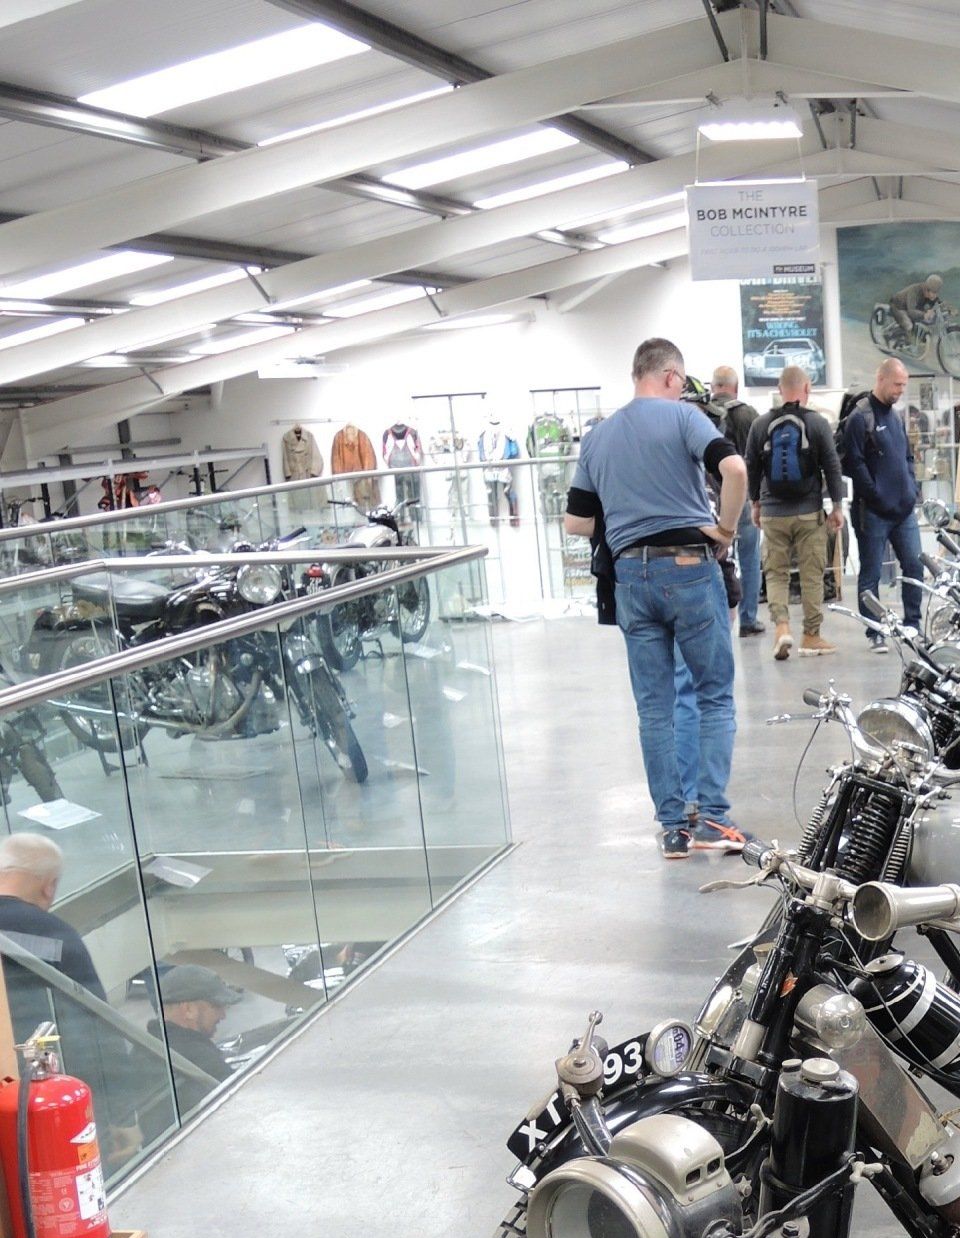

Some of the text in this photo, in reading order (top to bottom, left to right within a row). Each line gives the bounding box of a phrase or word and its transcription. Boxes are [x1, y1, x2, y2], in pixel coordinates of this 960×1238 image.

[737, 190, 764, 202] THE
[696, 205, 807, 221] BOB MCINTYRE
[710, 223, 795, 237] COLLECTION
